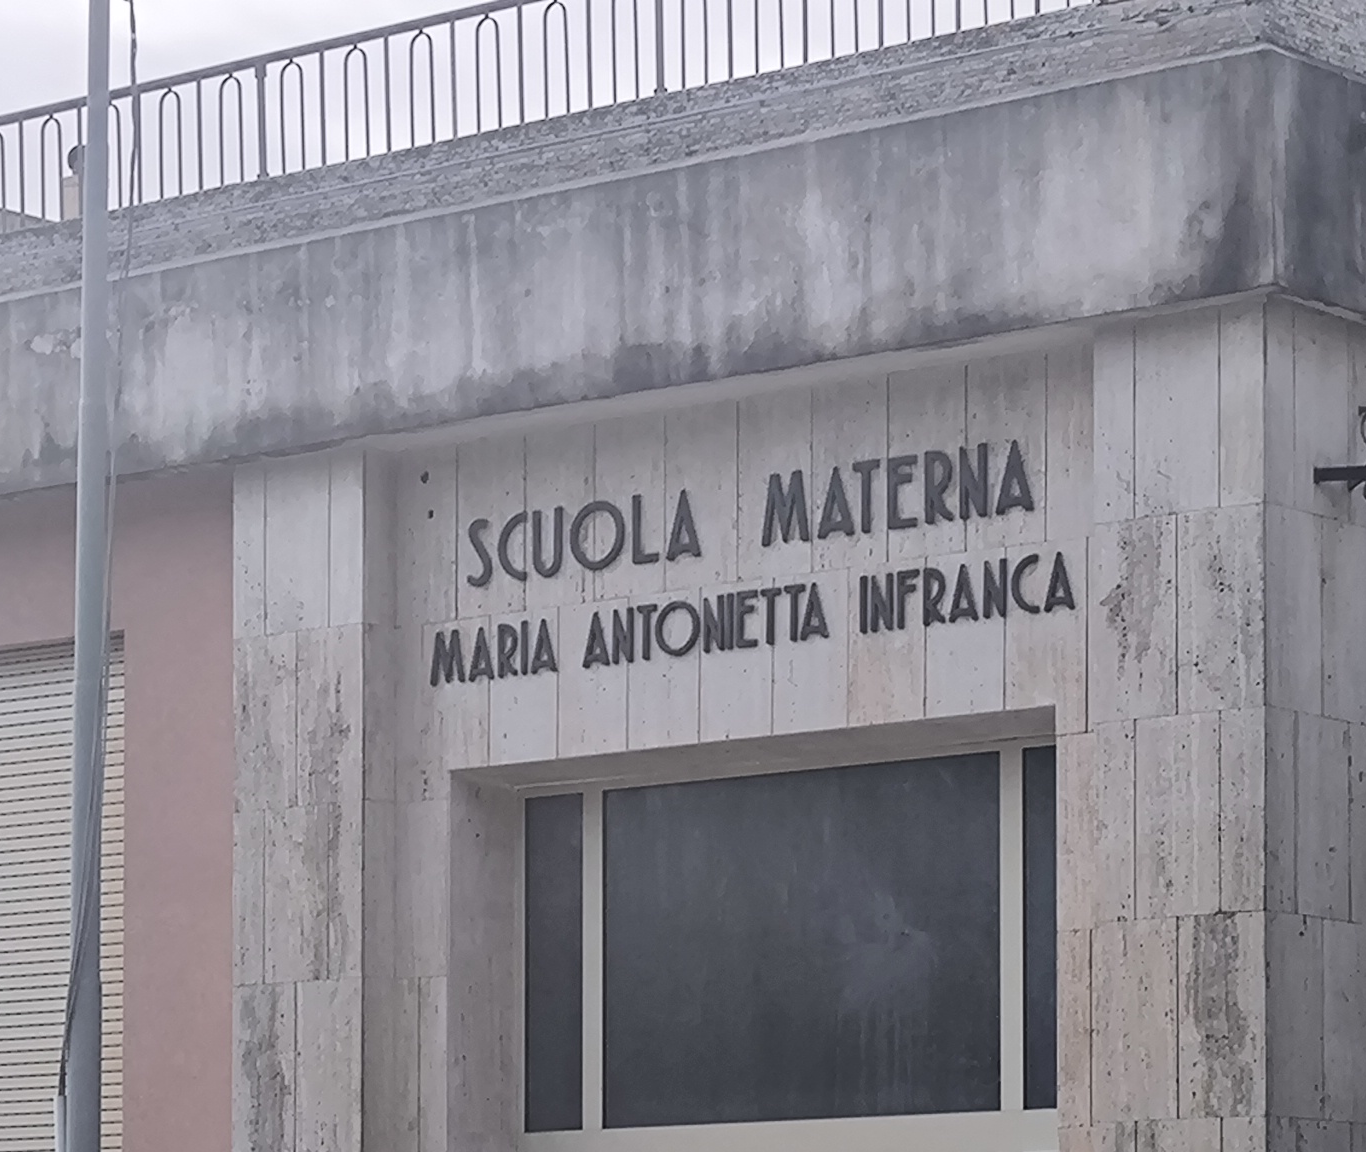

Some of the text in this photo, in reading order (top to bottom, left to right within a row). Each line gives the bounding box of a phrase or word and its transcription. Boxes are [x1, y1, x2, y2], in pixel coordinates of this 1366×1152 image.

[467, 440, 1035, 587] SCUOLA MATERNA
[430, 552, 1076, 687] MARIA ANTONIETTA INFRANCA
